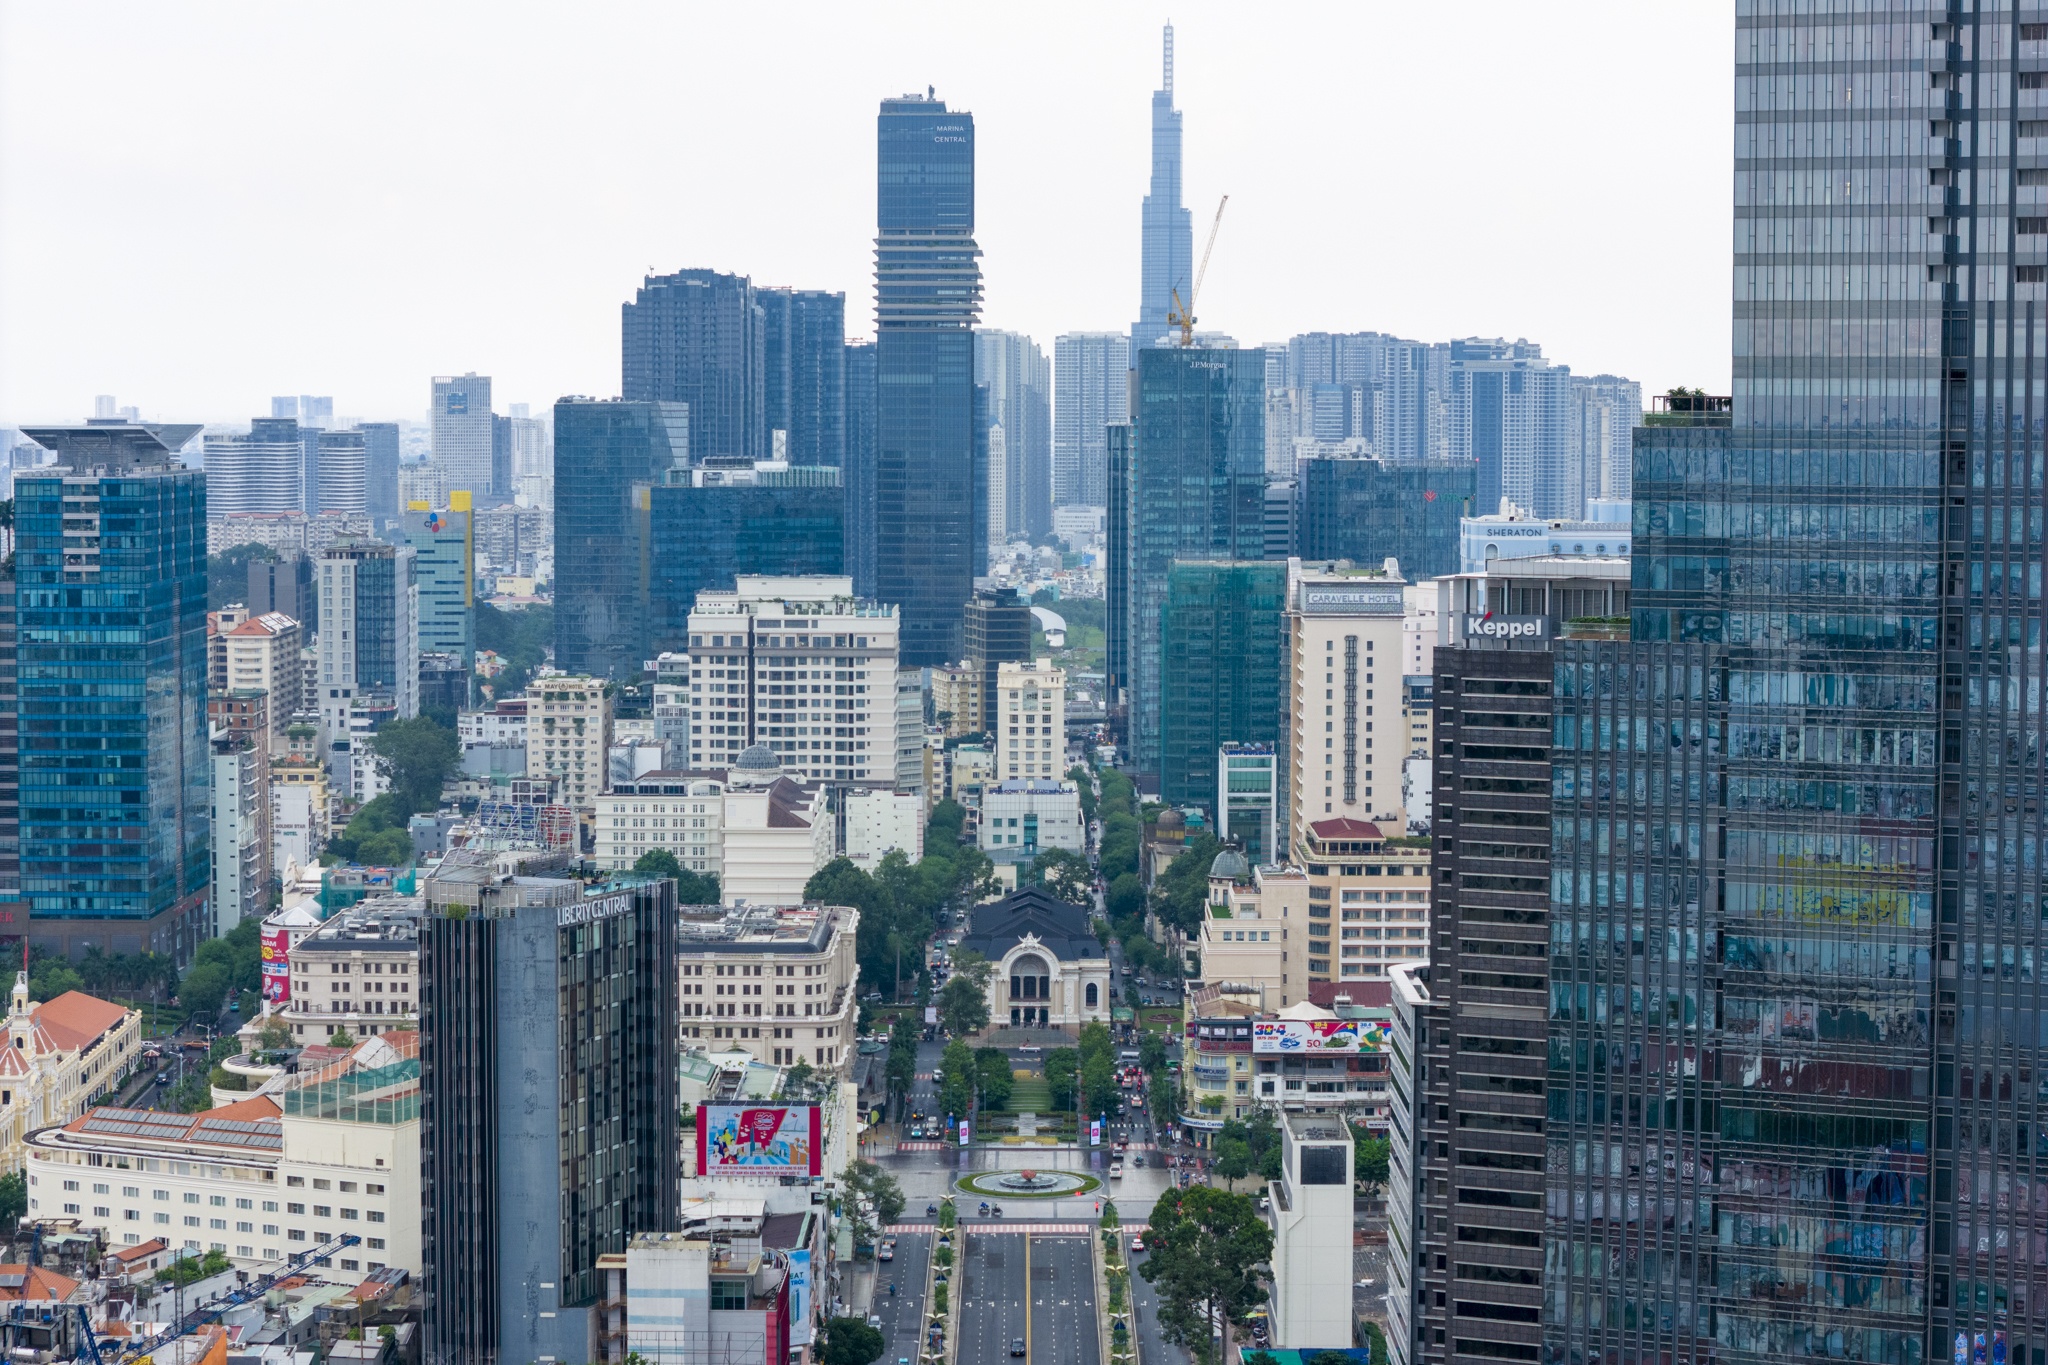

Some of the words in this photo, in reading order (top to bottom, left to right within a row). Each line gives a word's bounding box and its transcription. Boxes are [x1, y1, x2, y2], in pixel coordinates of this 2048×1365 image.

[1468, 617, 1542, 638] Keppel
[557, 903, 591, 926] LIBERTY
[592, 894, 630, 918] CENTRAL
